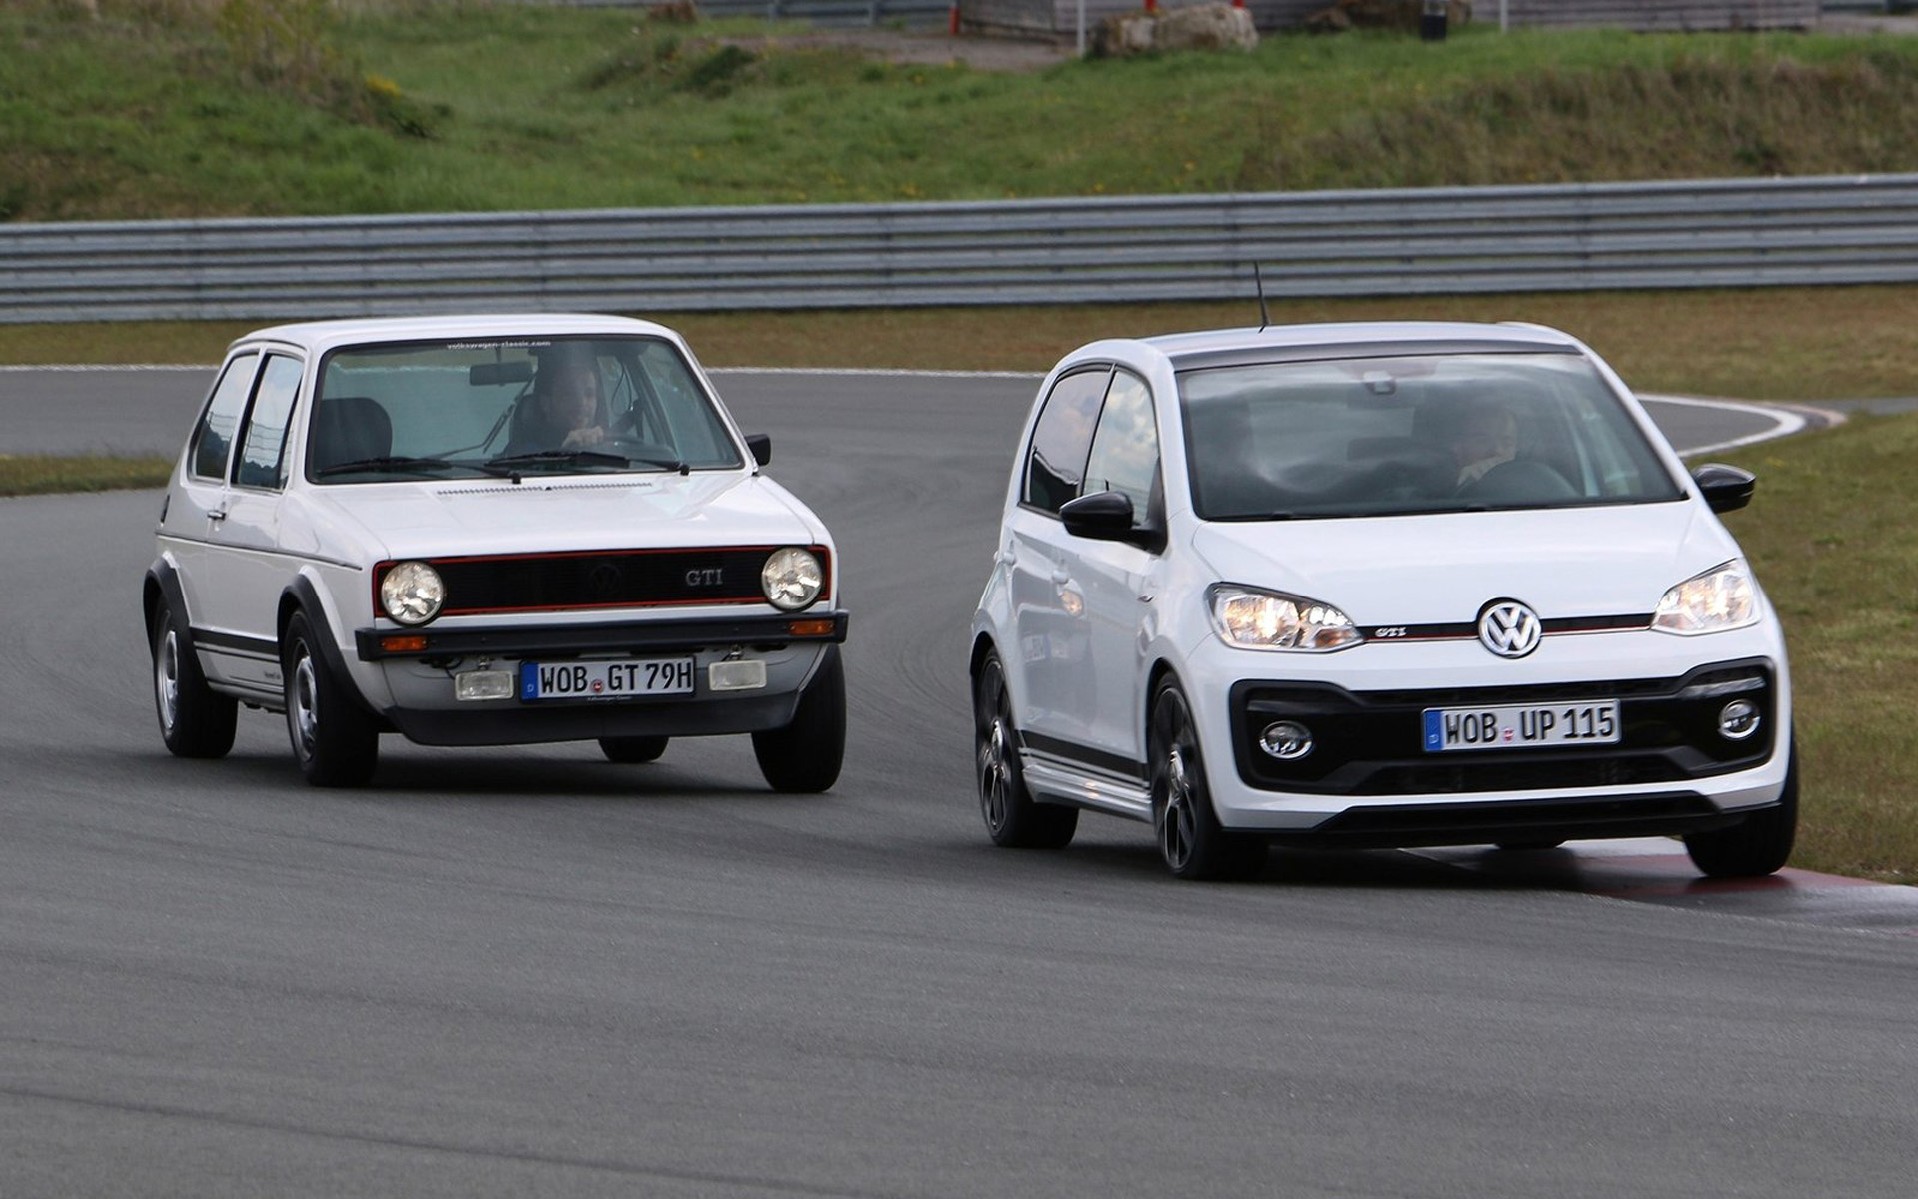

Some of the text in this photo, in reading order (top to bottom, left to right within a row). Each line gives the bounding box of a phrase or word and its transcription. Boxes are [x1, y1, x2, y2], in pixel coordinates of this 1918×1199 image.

[685, 569, 724, 586] GTI
[1375, 627, 1407, 638] GTI
[1479, 602, 1541, 655] VW
[540, 662, 692, 693] WOB GT 79H
[1445, 707, 1615, 744] WOB UP 115
